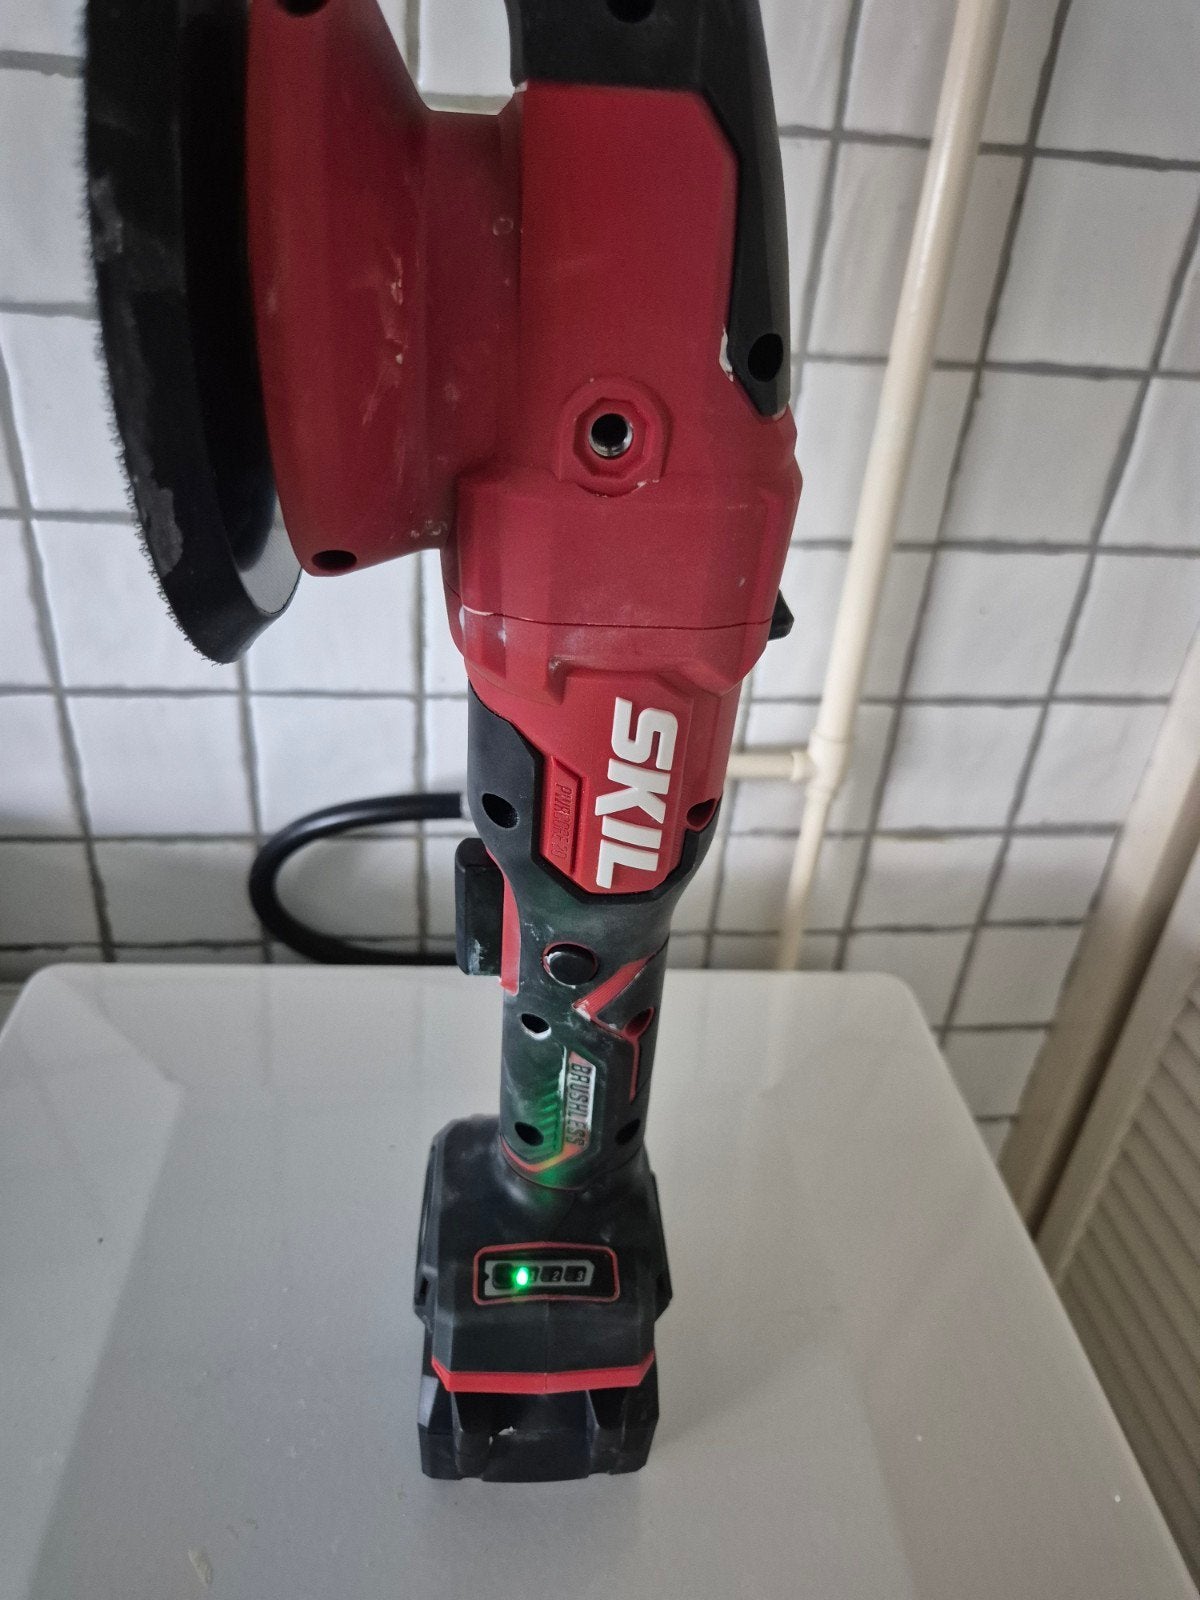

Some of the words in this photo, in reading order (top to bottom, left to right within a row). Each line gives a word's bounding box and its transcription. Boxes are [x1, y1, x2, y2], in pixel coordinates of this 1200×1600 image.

[594, 697, 679, 889] SKIL
[566, 1063, 592, 1146] BRUSHLESS
[552, 1271, 559, 1281] 2
[577, 1271, 584, 1281] 3
